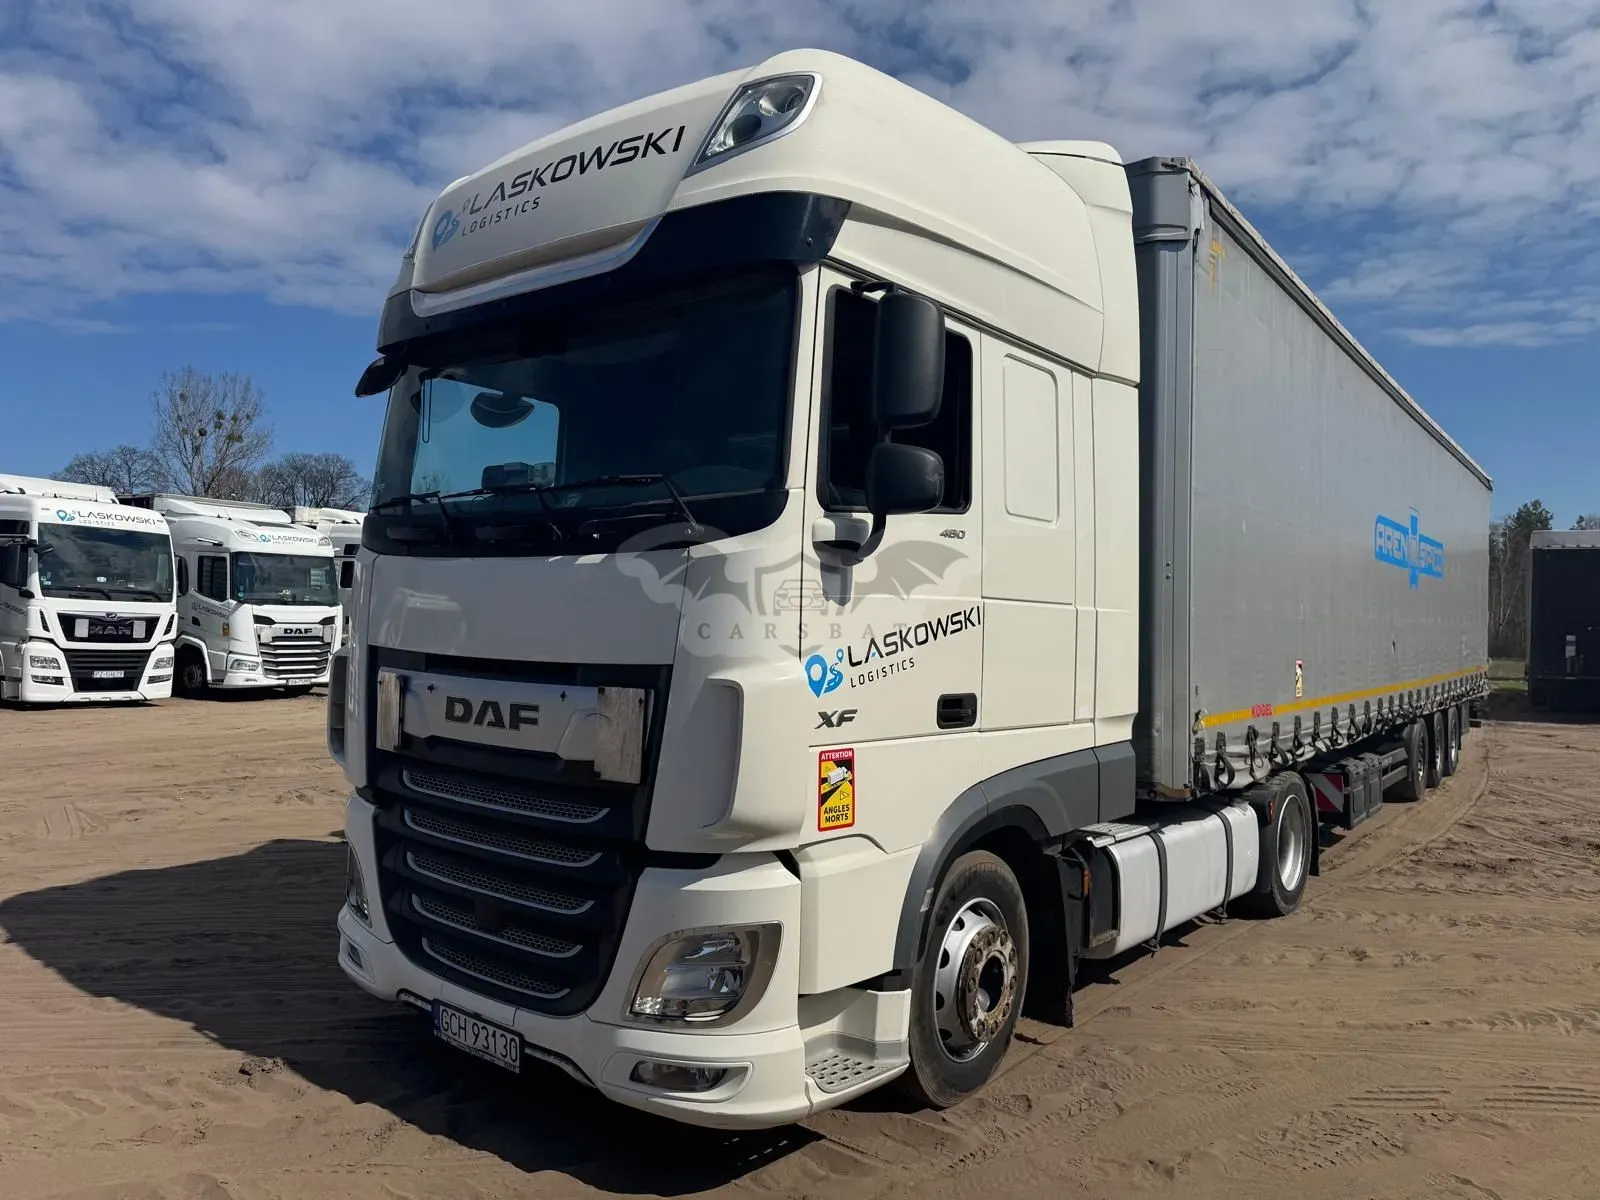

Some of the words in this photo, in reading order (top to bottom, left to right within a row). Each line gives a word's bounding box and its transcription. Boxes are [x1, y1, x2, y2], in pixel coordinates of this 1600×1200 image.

[468, 125, 686, 216] LASKOWSKI
[461, 196, 541, 236] LOGISTICS
[77, 510, 156, 526] LASKOWSKI
[89, 625, 132, 635] MAN
[847, 605, 981, 667] LASKOWSKI
[850, 657, 916, 688] LOGISTICS
[445, 695, 540, 731] DAF
[814, 708, 858, 730] XF
[821, 750, 853, 760] ATTENTION
[823, 804, 850, 815] ANGLES
[825, 812, 849, 824] MORTS
[441, 1008, 467, 1042] GCH
[472, 1022, 518, 1063] 93130
